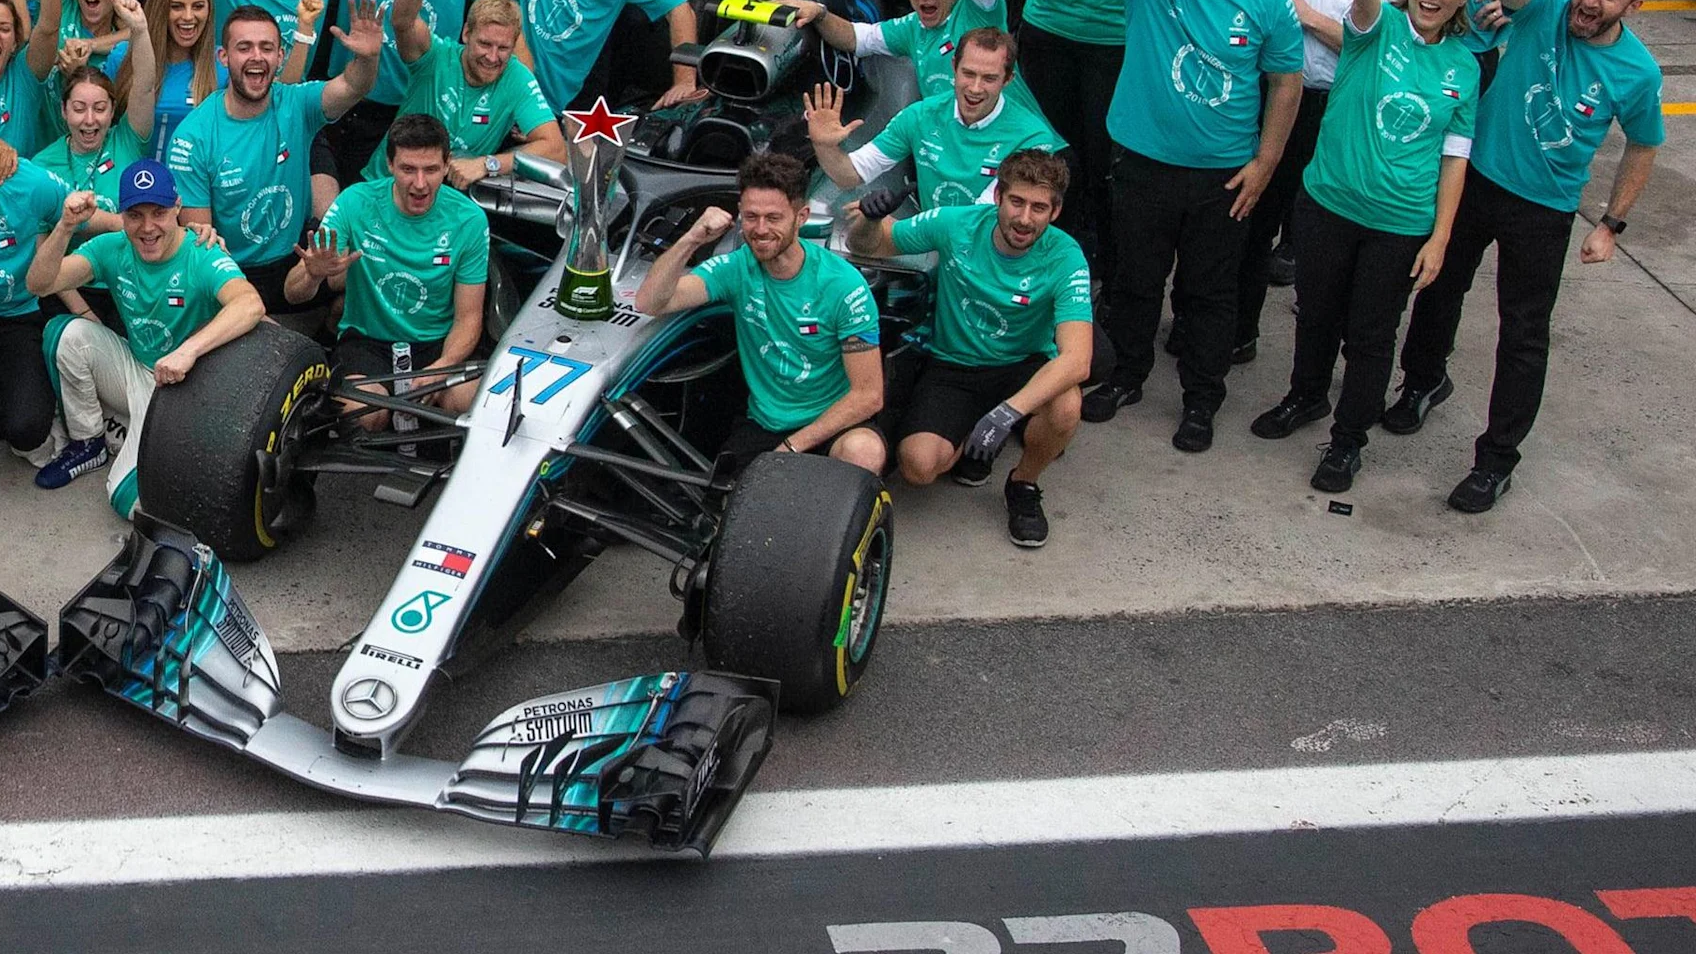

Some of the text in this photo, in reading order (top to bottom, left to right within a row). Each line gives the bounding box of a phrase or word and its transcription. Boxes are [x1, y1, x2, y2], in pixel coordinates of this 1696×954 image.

[534, 24, 551, 41] 2018
[122, 289, 137, 301] UBS
[488, 346, 594, 405] 77
[425, 542, 475, 558] TOMMY
[414, 561, 463, 578] HILFIGER
[226, 598, 260, 642] PETRONAS
[360, 644, 424, 670] PIRELLI
[523, 697, 593, 718] PETRONAS
[526, 711, 593, 742] SYNTIUM
